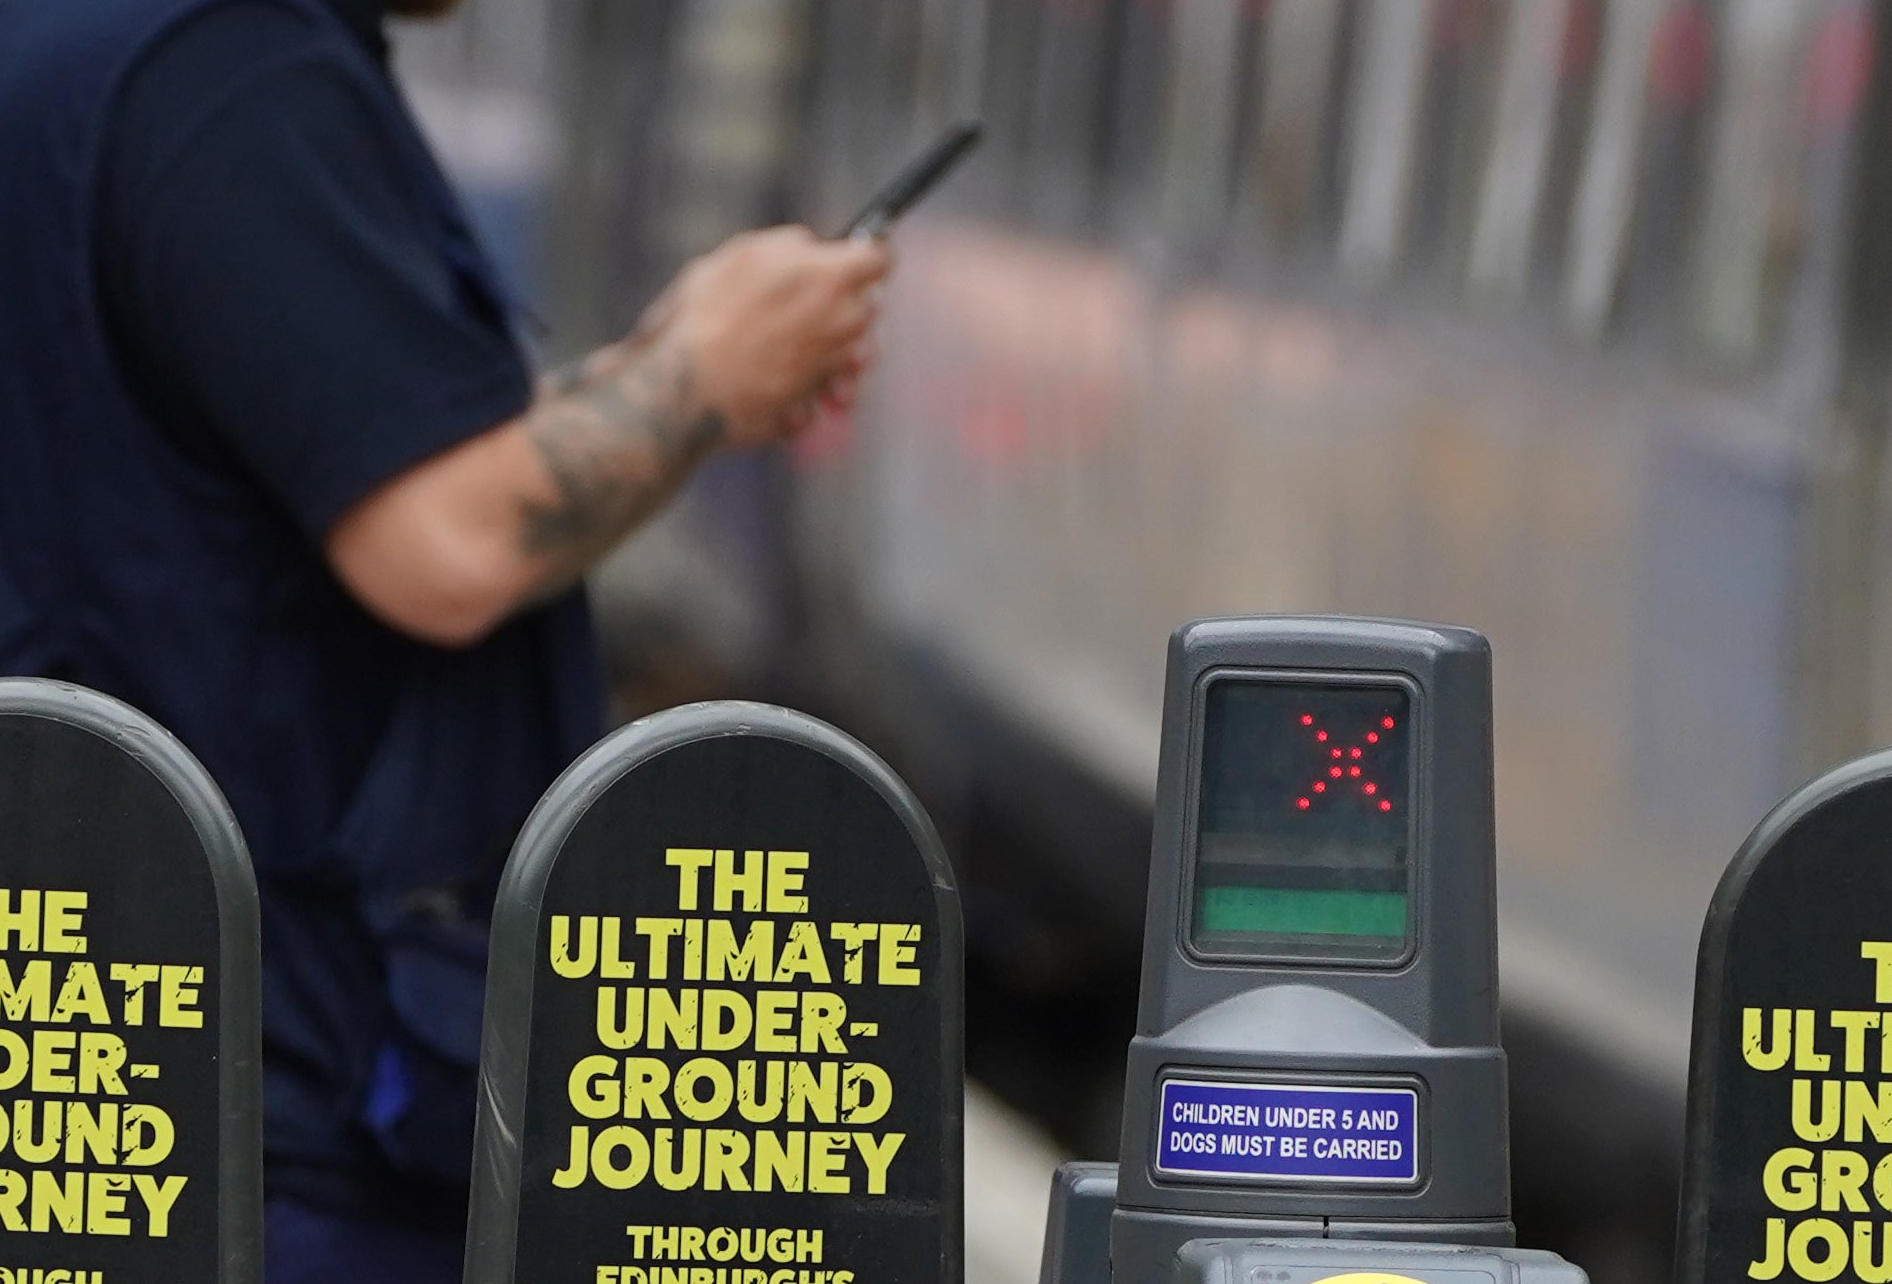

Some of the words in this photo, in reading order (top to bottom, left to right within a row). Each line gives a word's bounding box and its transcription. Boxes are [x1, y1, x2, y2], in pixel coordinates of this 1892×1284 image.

[667, 849, 809, 913] THE
[551, 916, 921, 985] ULTIMATE
[597, 987, 878, 1053] UNDER-
[569, 1055, 892, 1123] GROUND
[1172, 1102, 1260, 1127] CHILDREN
[1264, 1106, 1337, 1130] UNDER
[1341, 1110, 1353, 1130] 5
[1357, 1110, 1399, 1131] AND
[552, 1126, 903, 1194] JOURNEY
[1170, 1130, 1217, 1154] DOGS
[1220, 1133, 1275, 1157] MUST
[1279, 1136, 1307, 1158] BE
[1313, 1137, 1402, 1161] CARRIED
[628, 1226, 822, 1261] THROUGH
